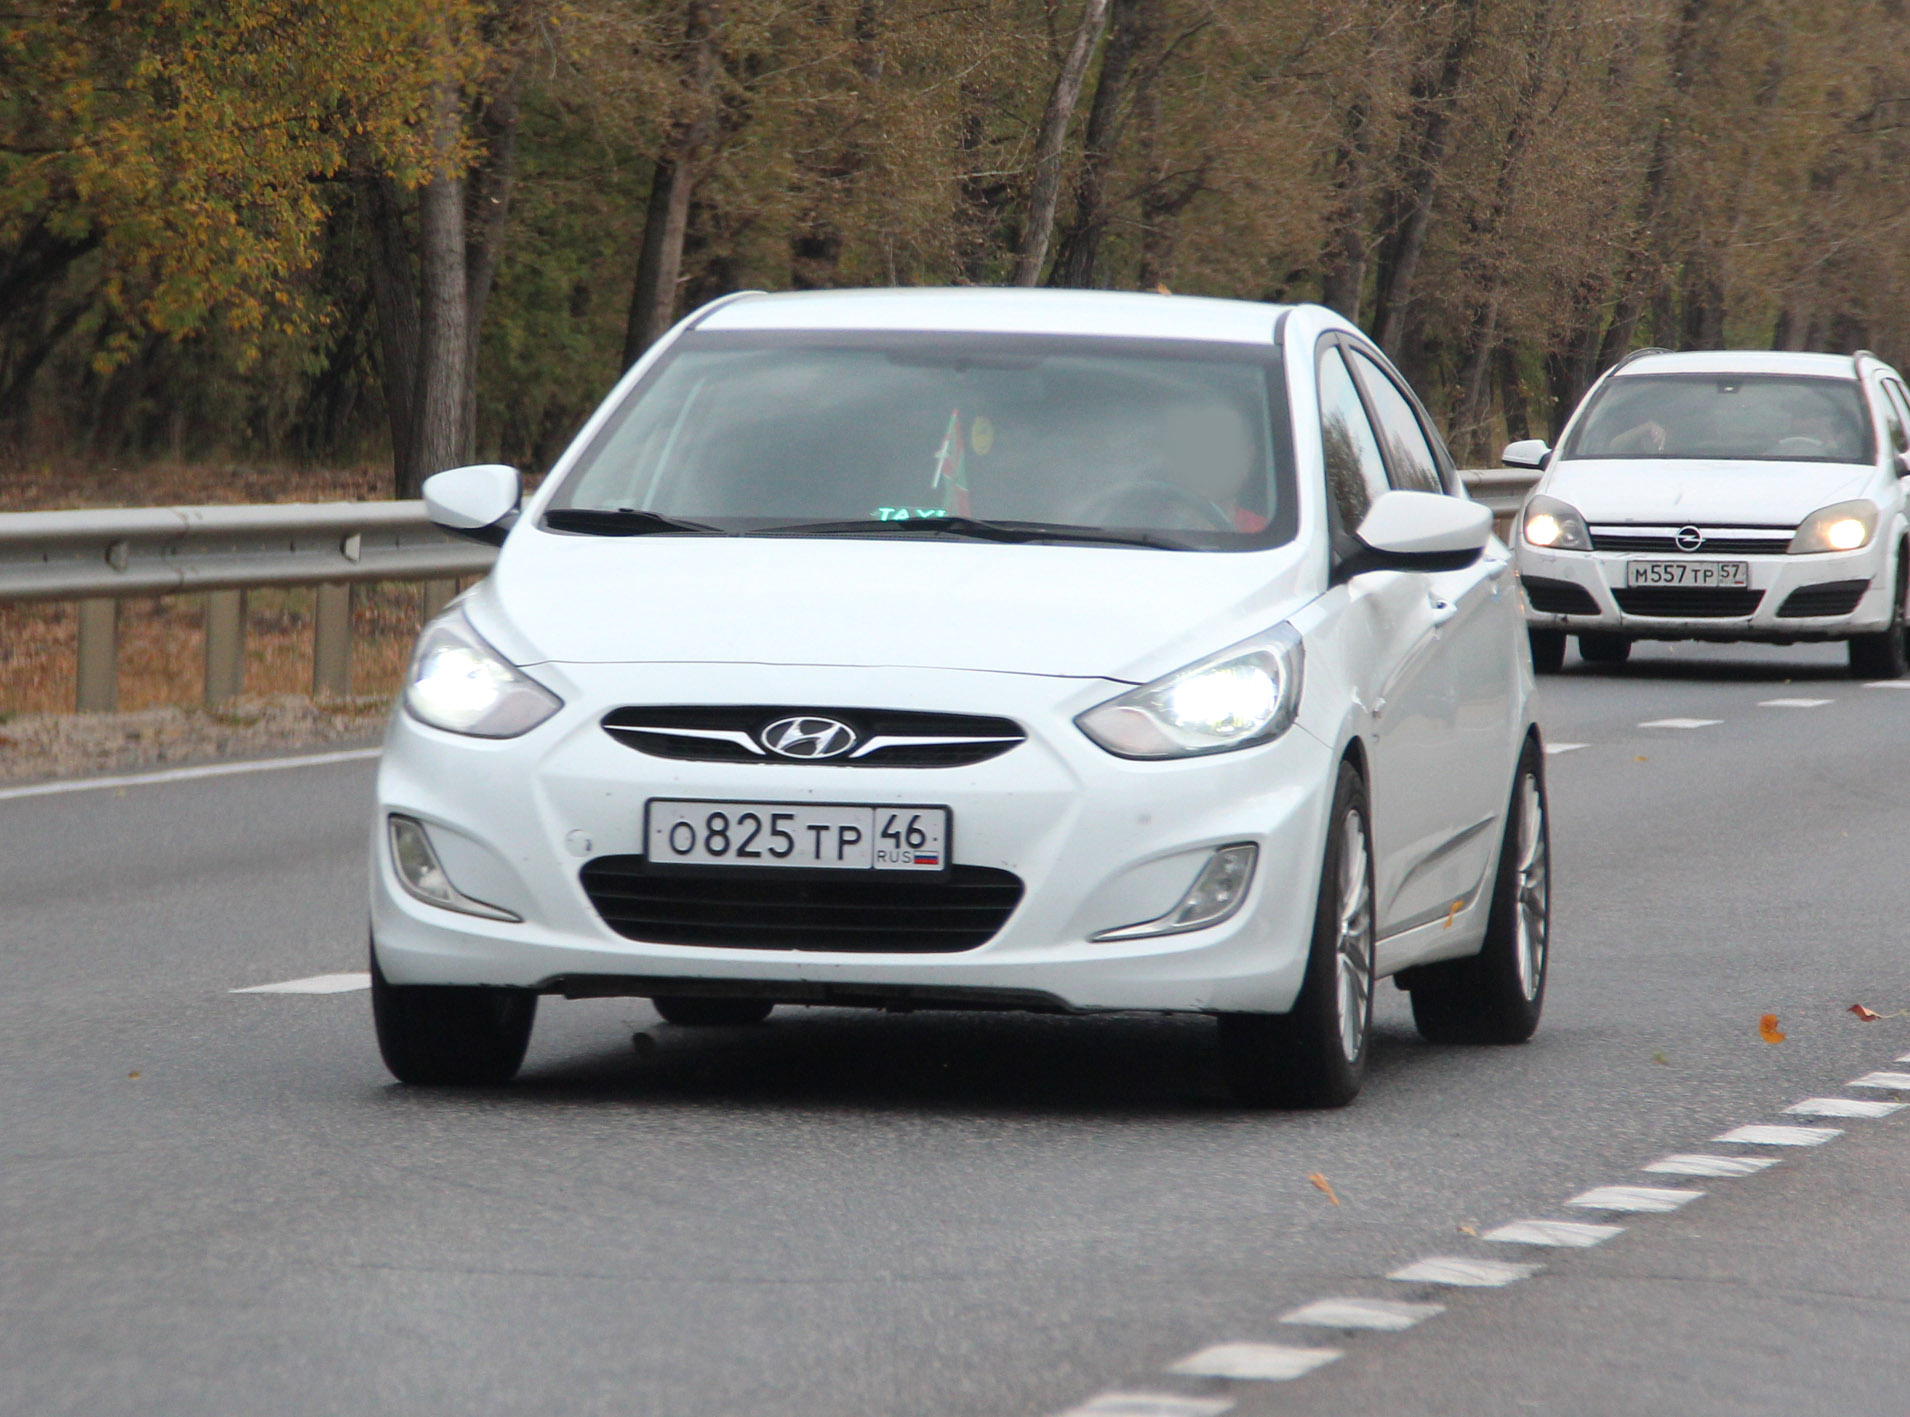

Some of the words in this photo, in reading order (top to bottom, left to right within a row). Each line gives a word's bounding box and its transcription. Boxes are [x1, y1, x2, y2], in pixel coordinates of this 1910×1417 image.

[1721, 564, 1739, 578] 57
[881, 814, 926, 849] 46
[877, 850, 912, 863] RUS
